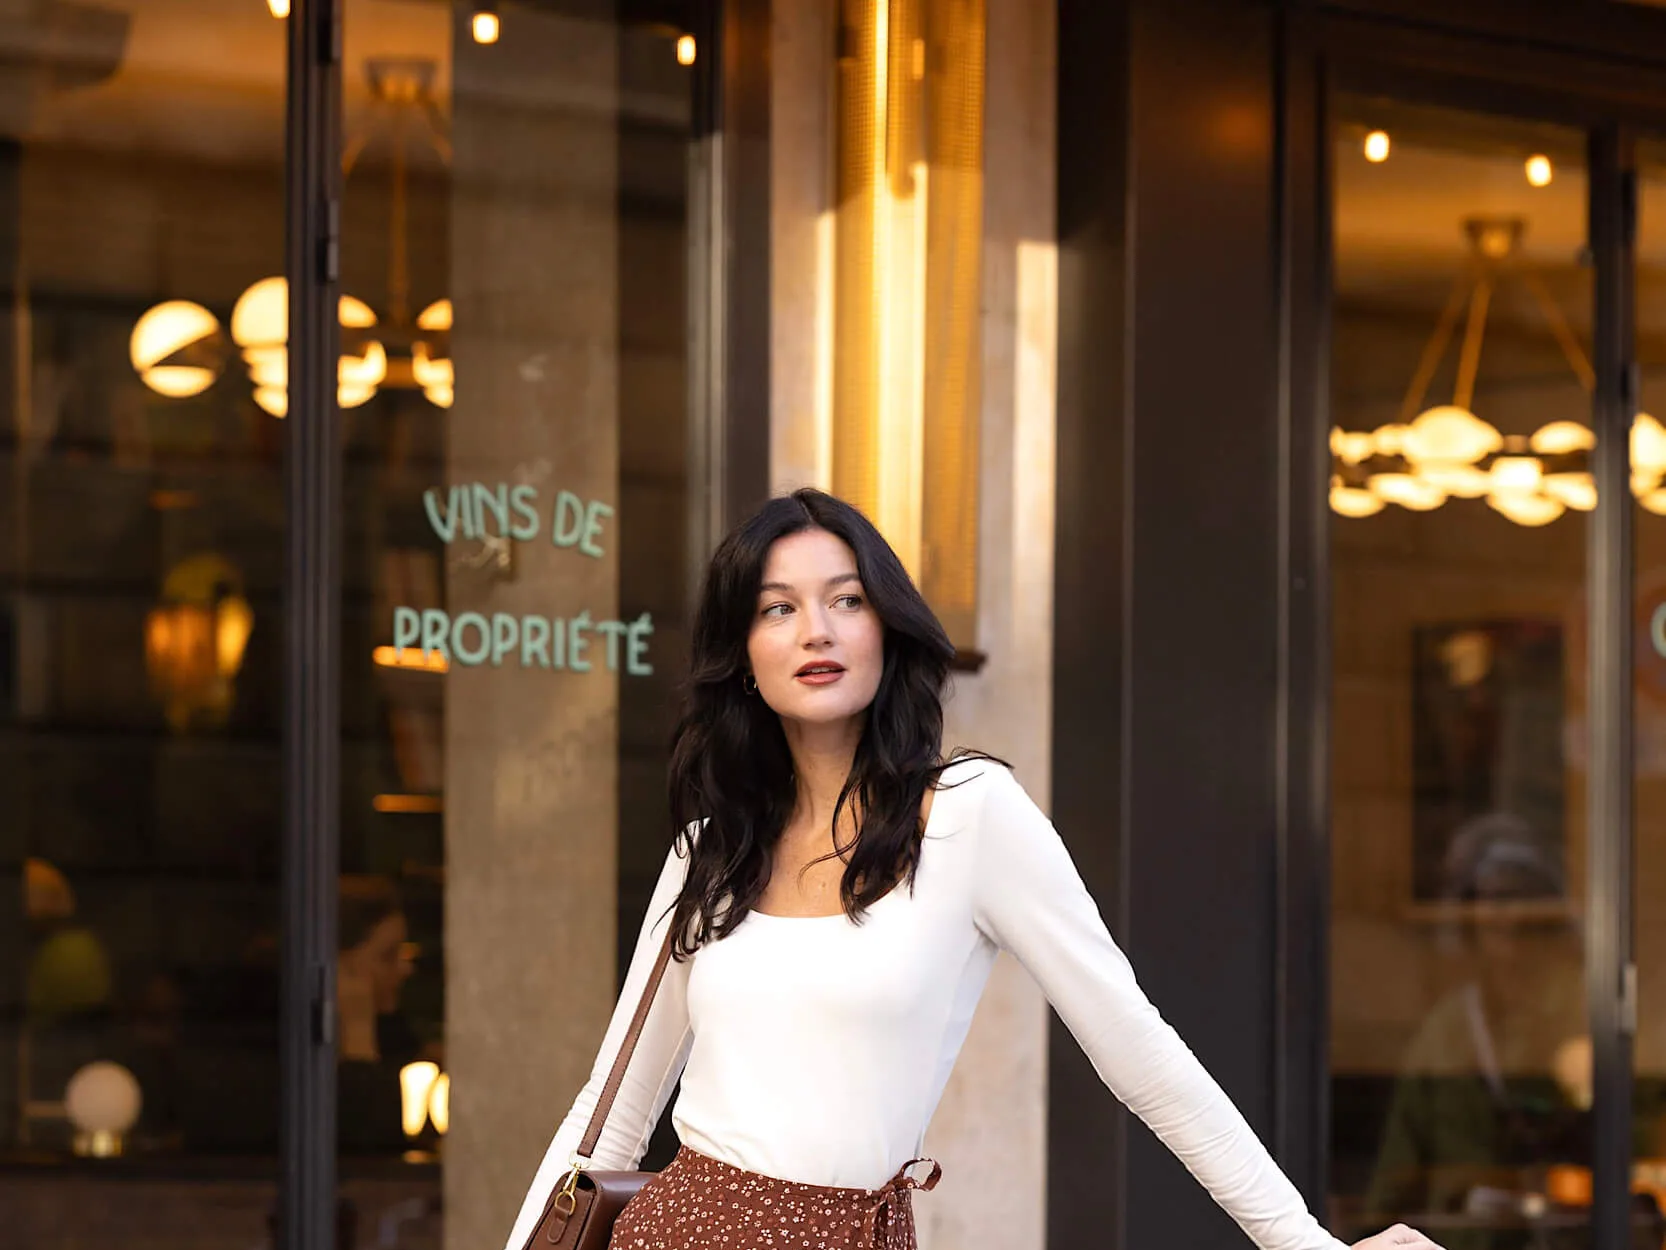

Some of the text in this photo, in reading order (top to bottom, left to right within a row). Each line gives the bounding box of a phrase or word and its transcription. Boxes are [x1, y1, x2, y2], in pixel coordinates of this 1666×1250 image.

[423, 482, 614, 558] VINS DE
[394, 606, 654, 675] PROPRIÉTÉ
